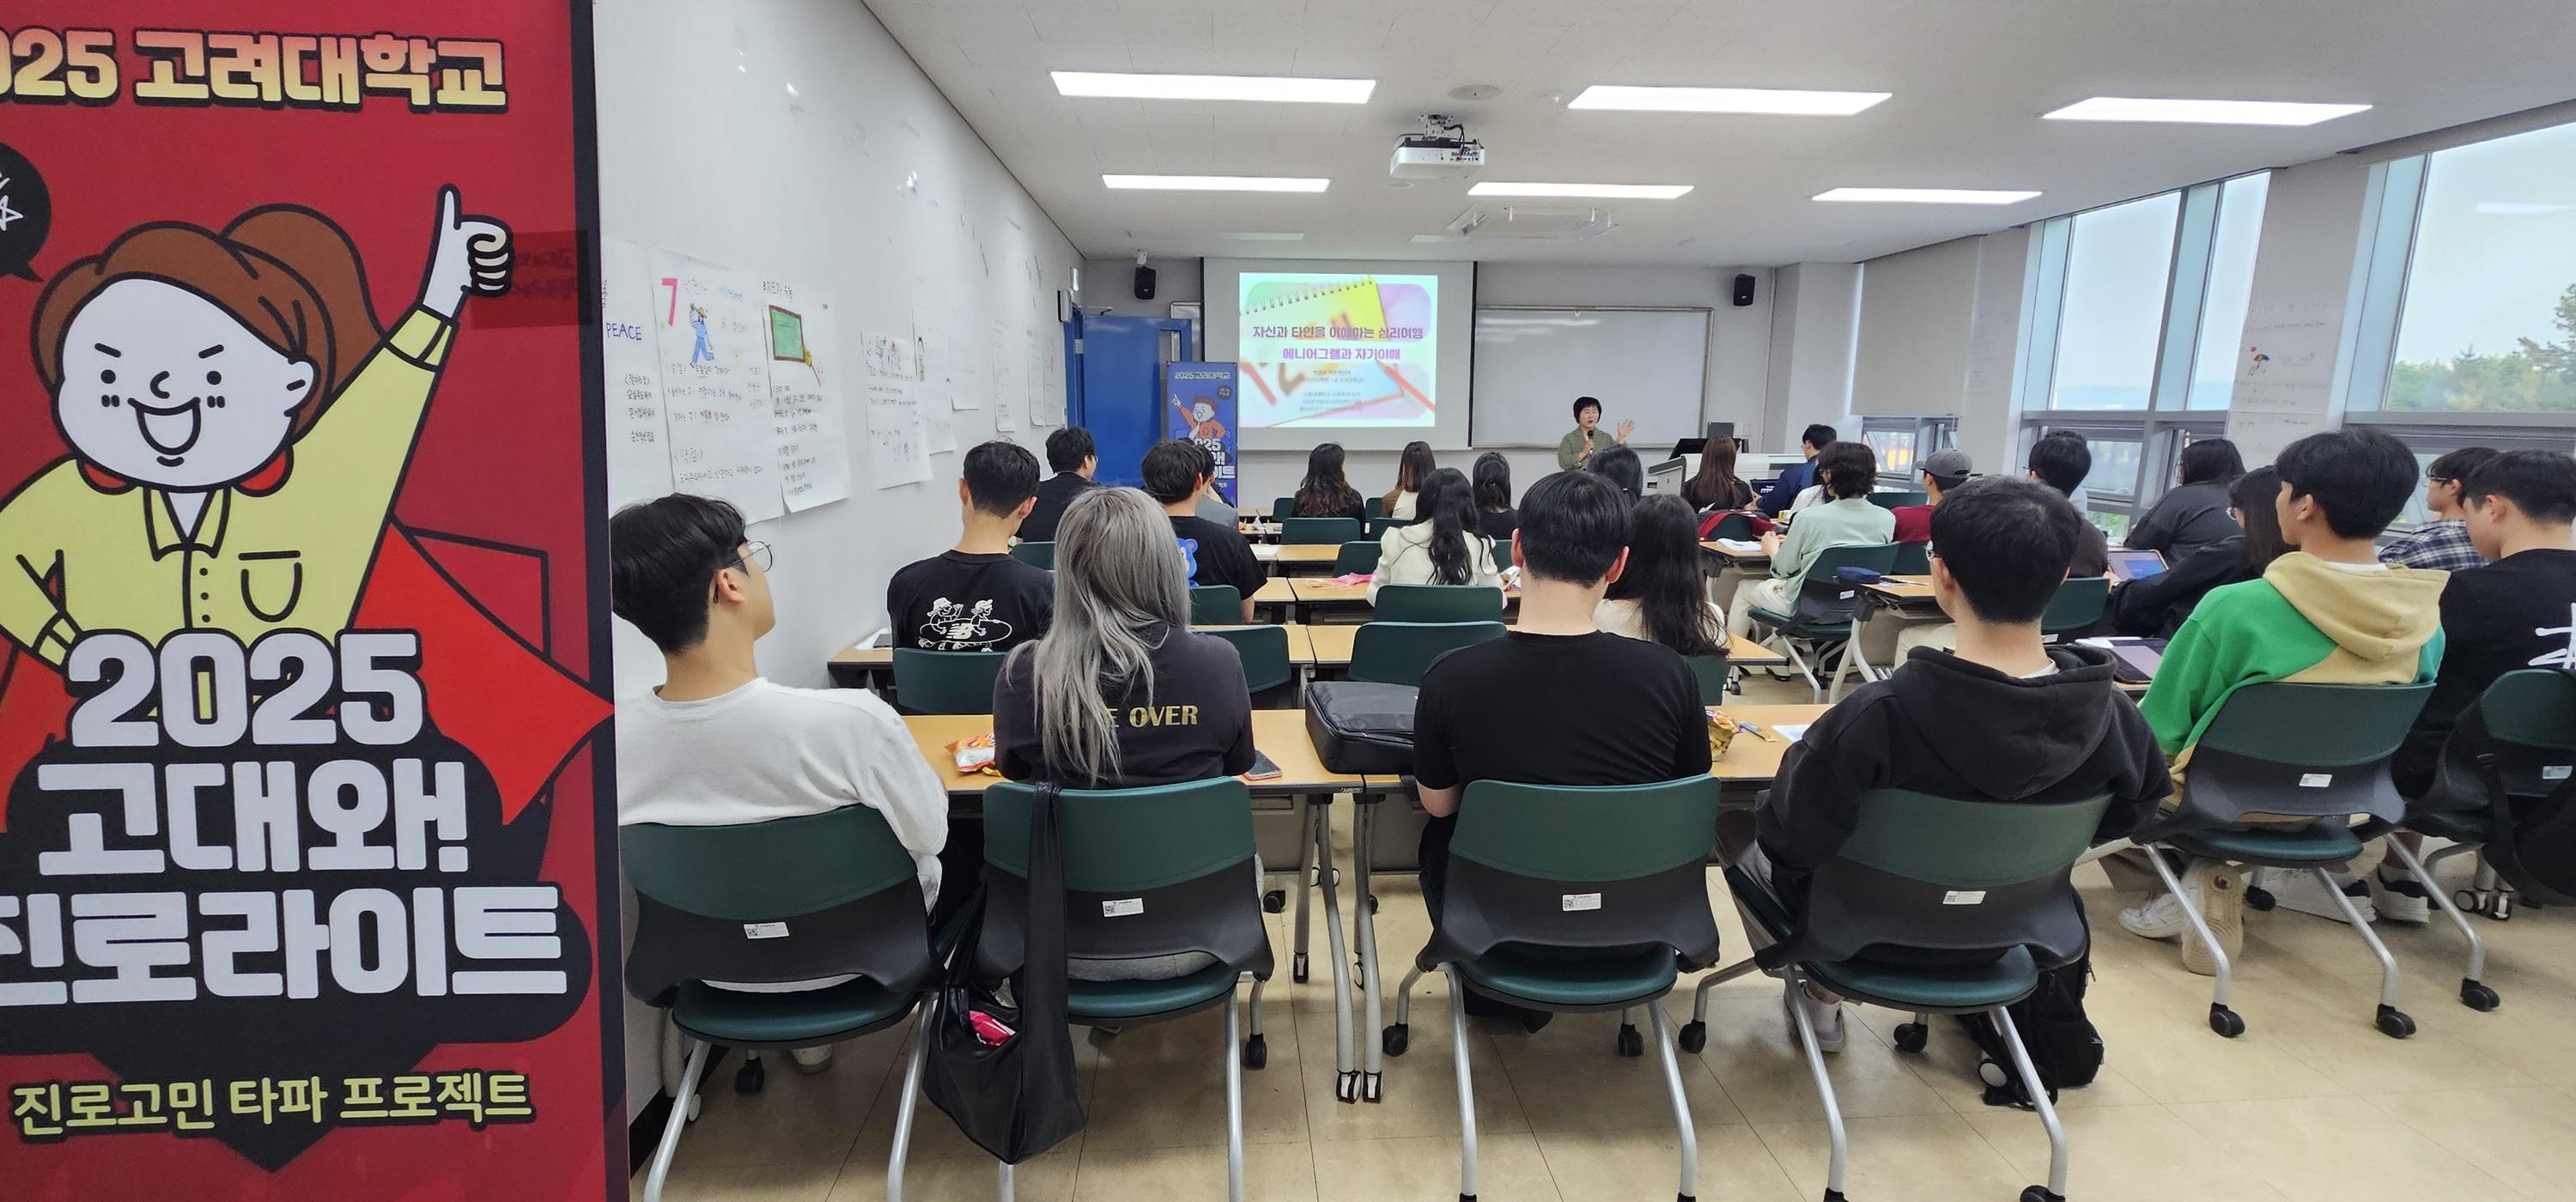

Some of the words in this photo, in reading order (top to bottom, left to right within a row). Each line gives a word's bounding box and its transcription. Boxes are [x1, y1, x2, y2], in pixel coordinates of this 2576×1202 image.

[0, 28, 118, 97] 25
[136, 30, 506, 106] 고려대학교
[606, 322, 642, 341] PEACE
[1253, 325, 1287, 337] 자신과
[1291, 325, 1325, 338] 타인을
[68, 633, 423, 747] 2025
[1129, 705, 1199, 728] OVER
[38, 758, 470, 876] 고대와!
[13, 1078, 215, 1137] 진로고민
[229, 1076, 328, 1124] 타파
[340, 1073, 532, 1123] 프로젝트
